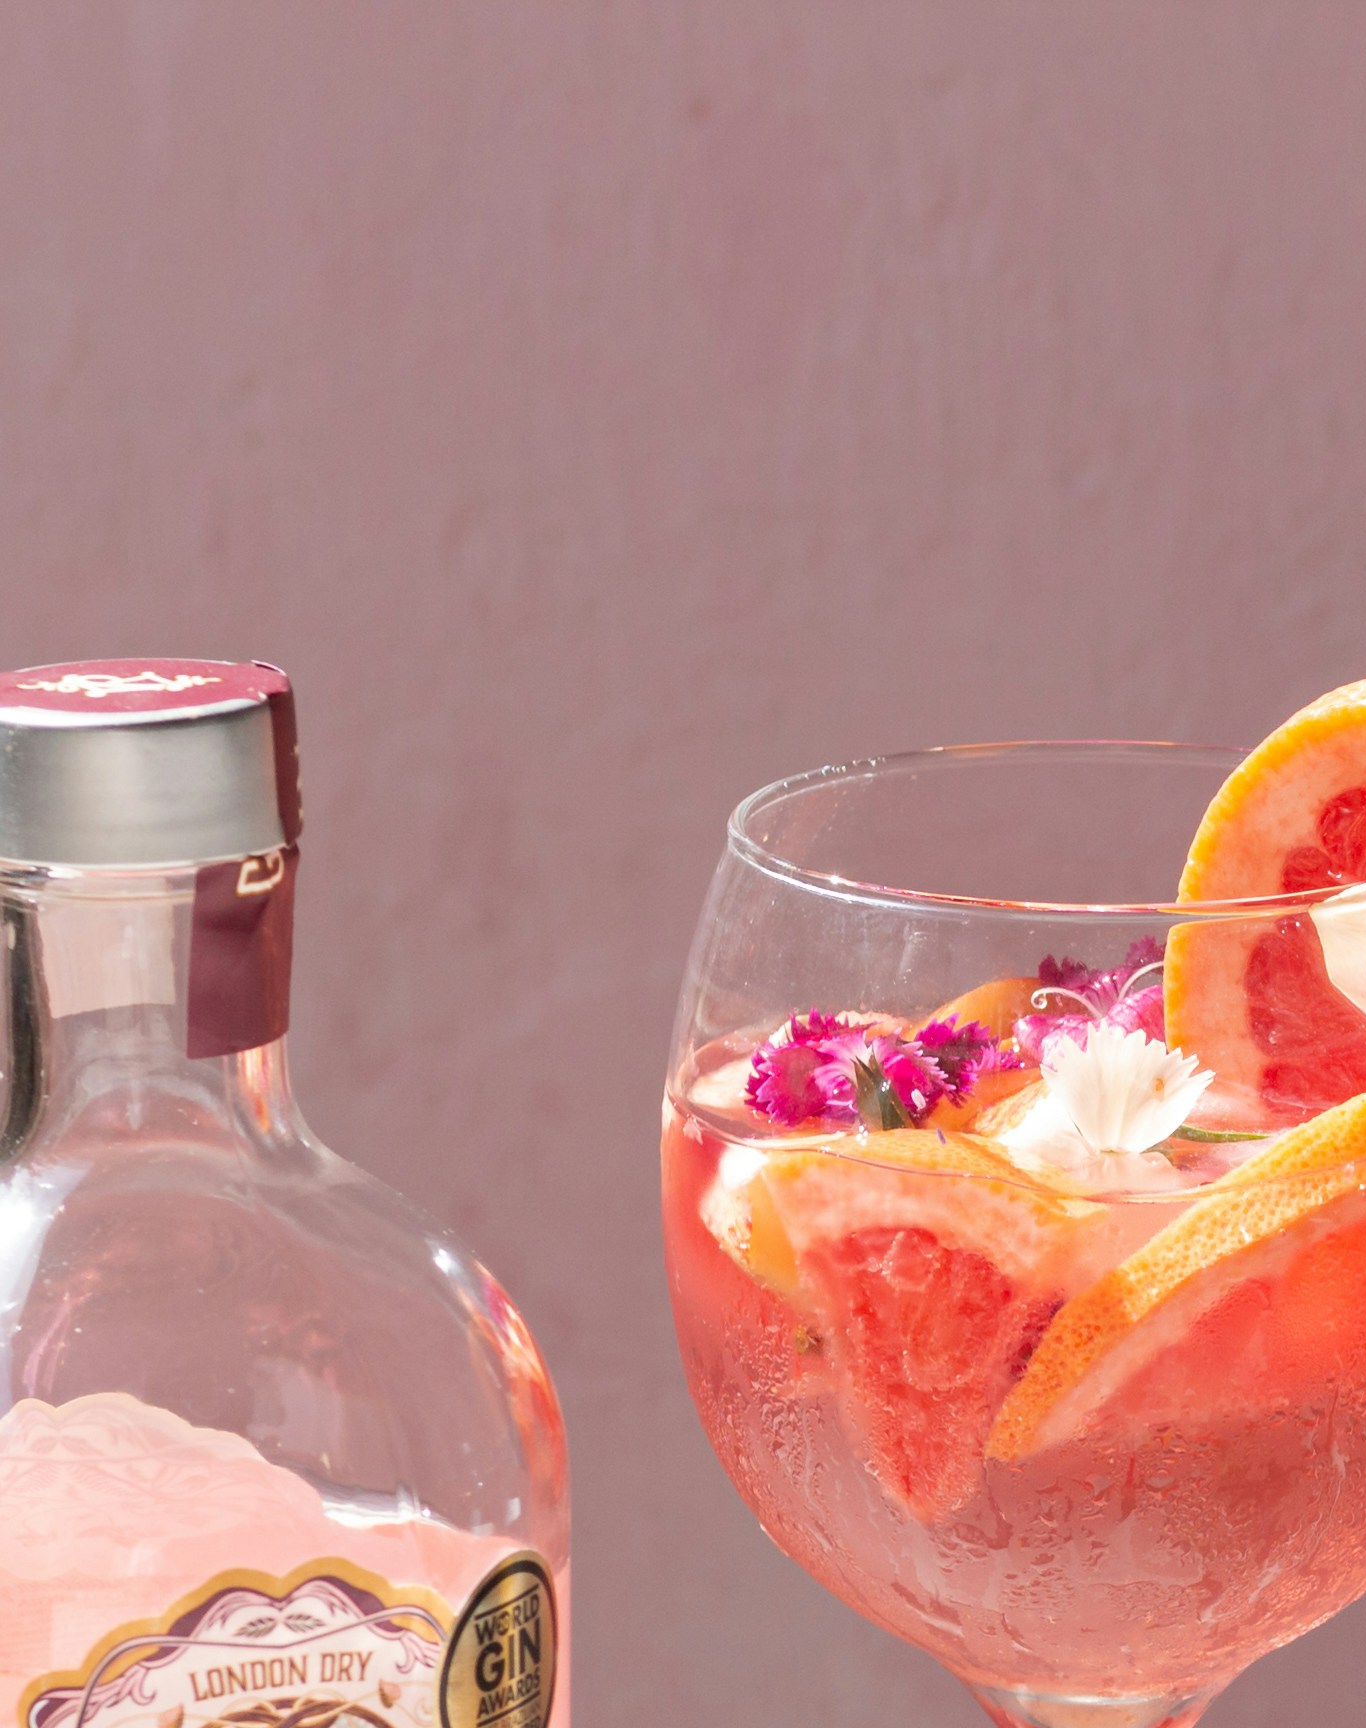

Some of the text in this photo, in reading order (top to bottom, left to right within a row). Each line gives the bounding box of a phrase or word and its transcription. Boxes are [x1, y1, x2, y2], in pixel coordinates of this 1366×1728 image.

[475, 1594, 541, 1646] WORLD
[189, 1651, 373, 1701] LONDON DRY
[475, 1617, 542, 1692] GIN
[476, 1667, 541, 1719] AWARDS
